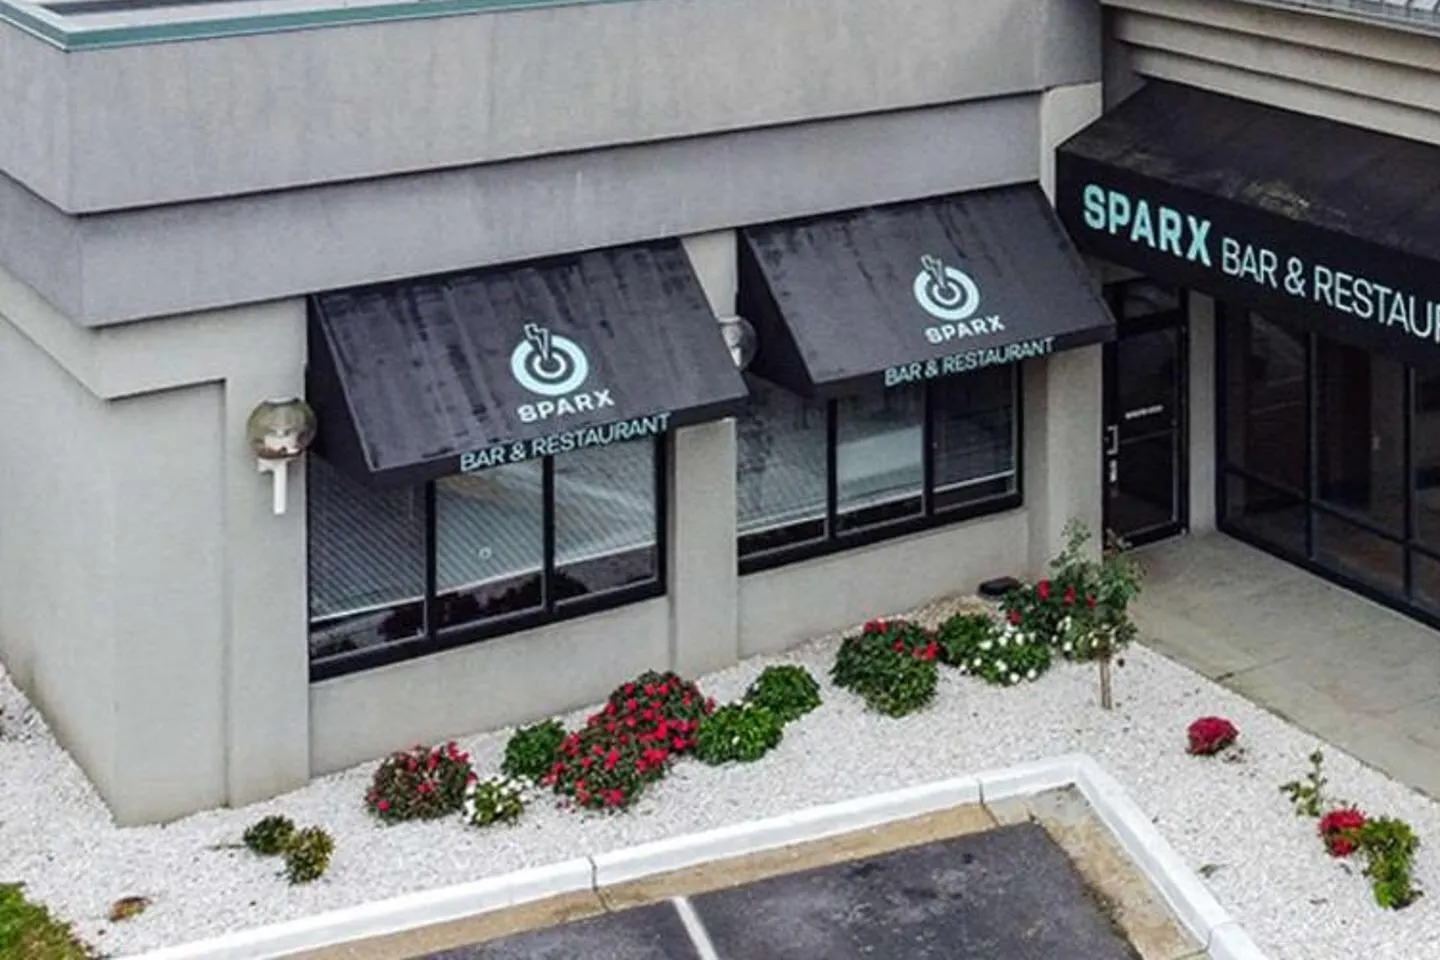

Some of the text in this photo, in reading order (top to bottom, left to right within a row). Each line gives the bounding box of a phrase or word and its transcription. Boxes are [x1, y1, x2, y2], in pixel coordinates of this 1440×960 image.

[1084, 184, 1212, 267] SPARX
[1223, 237, 1278, 289] BAR
[1284, 257, 1305, 297] &
[924, 315, 1005, 344] SPARX
[885, 336, 1055, 386] BAR & RESTAURANT
[517, 389, 615, 423] SPARX
[460, 411, 672, 472] BAR & RESTAURANT
